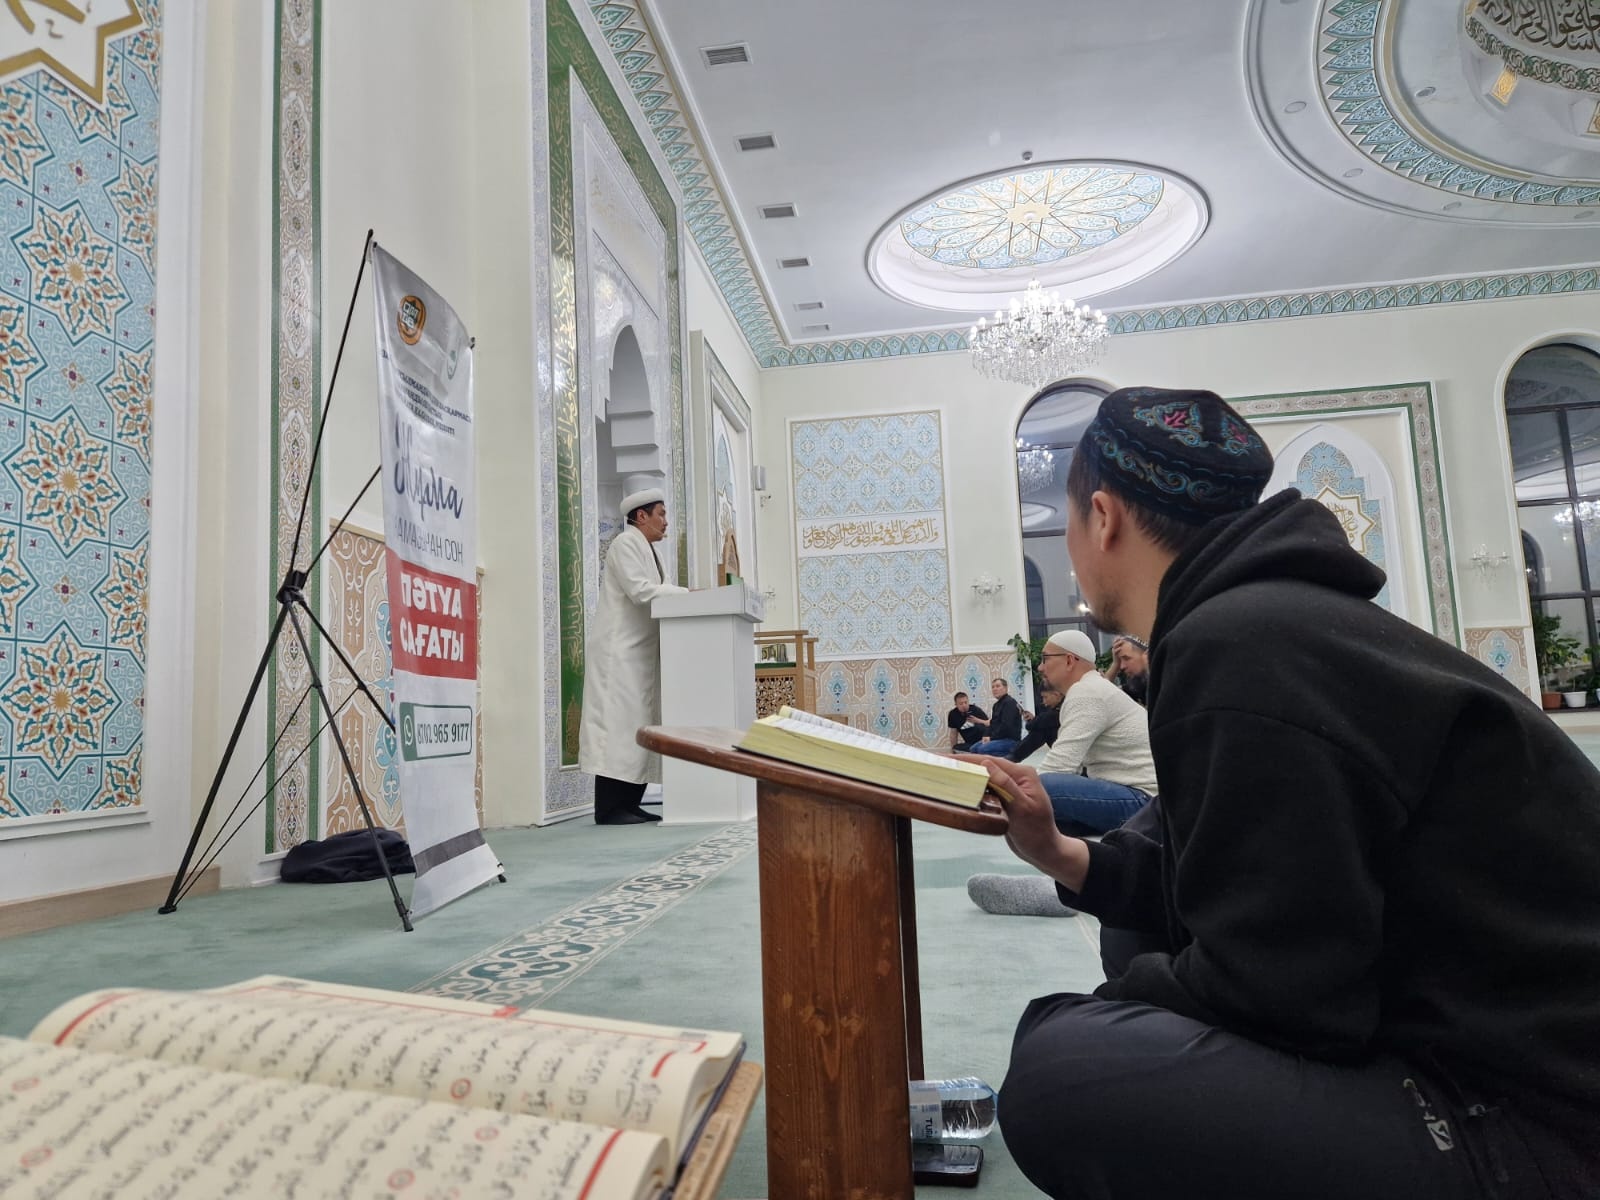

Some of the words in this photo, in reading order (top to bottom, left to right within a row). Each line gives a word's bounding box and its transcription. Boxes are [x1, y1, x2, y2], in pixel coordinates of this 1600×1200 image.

[400, 571, 463, 619] ПӘТУА
[400, 617, 464, 662] САҒАТЫ
[433, 723, 449, 744] 965
[451, 722, 470, 743] 9177
